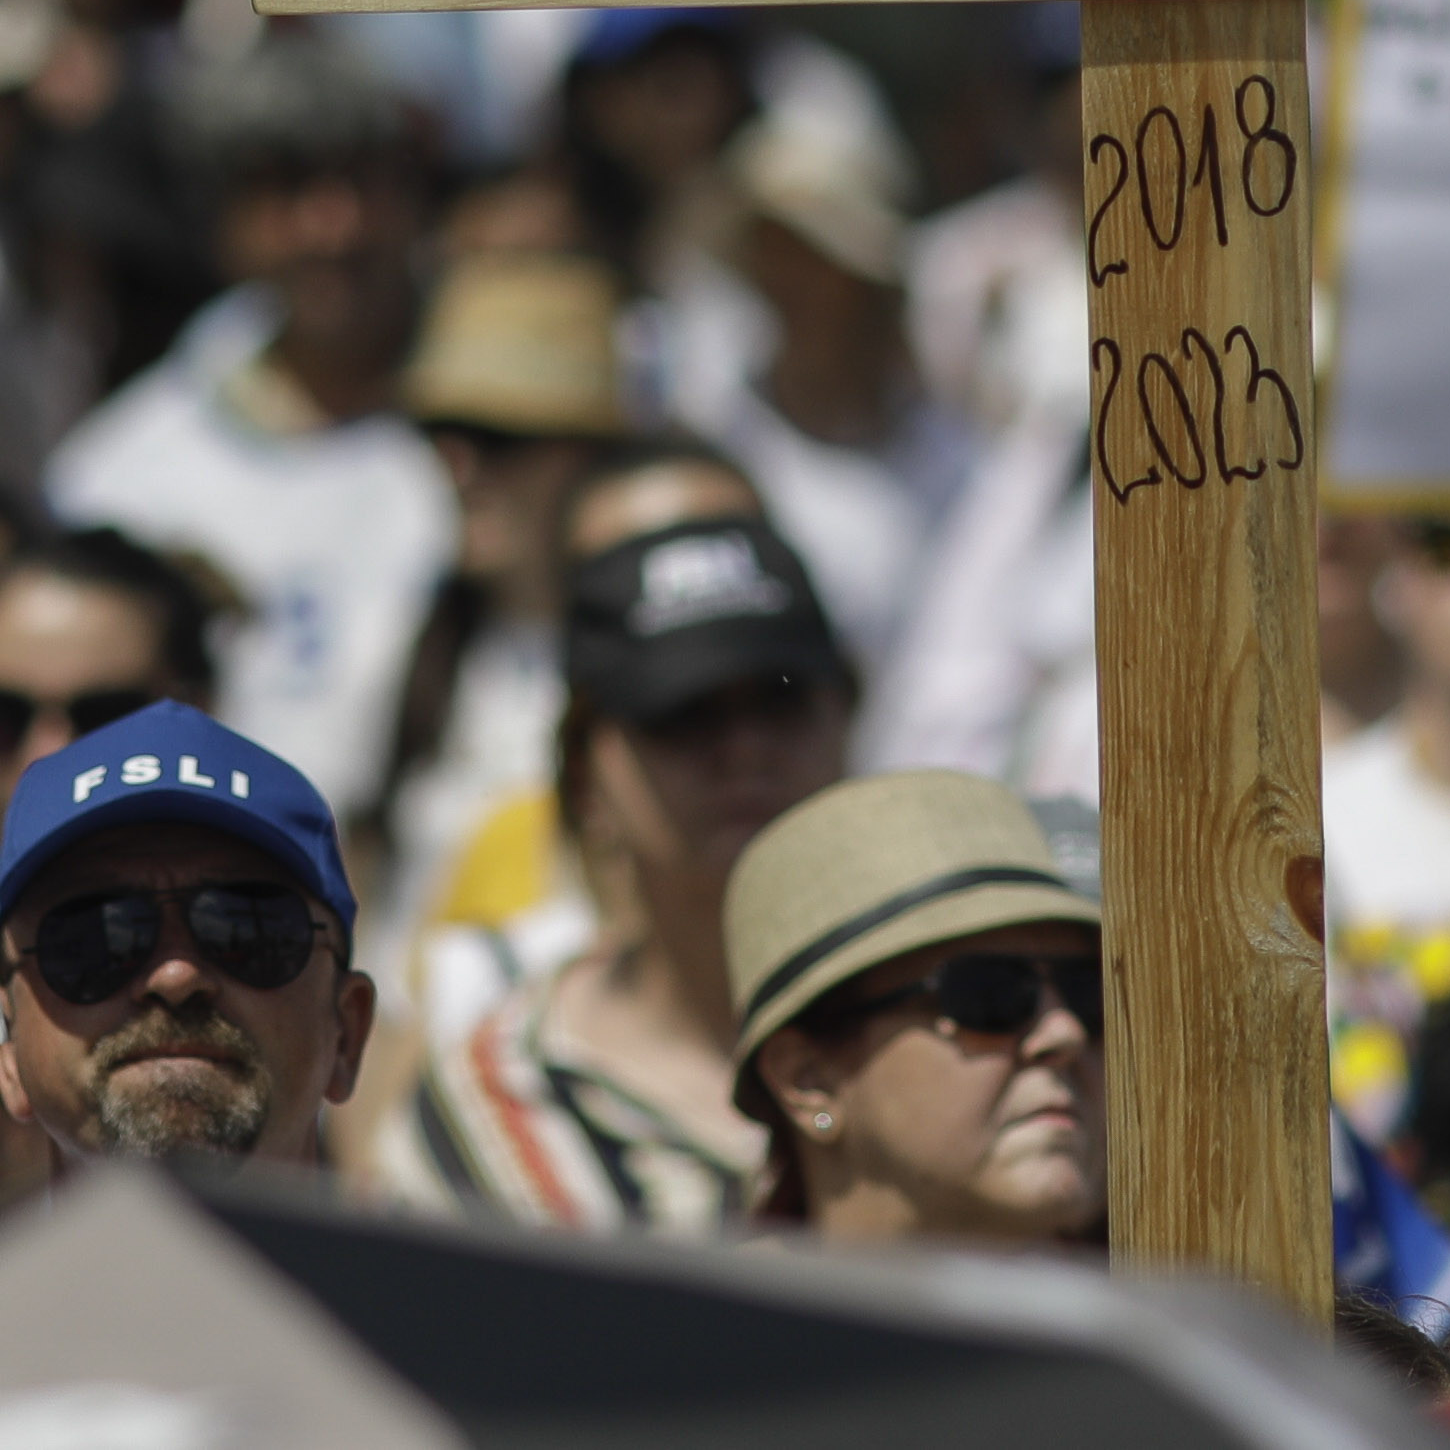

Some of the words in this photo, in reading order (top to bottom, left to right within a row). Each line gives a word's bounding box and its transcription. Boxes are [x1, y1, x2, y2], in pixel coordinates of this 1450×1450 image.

[1088, 74, 1298, 289] 2018
[1092, 325, 1304, 505] 2023
[72, 753, 251, 804] FSLI
